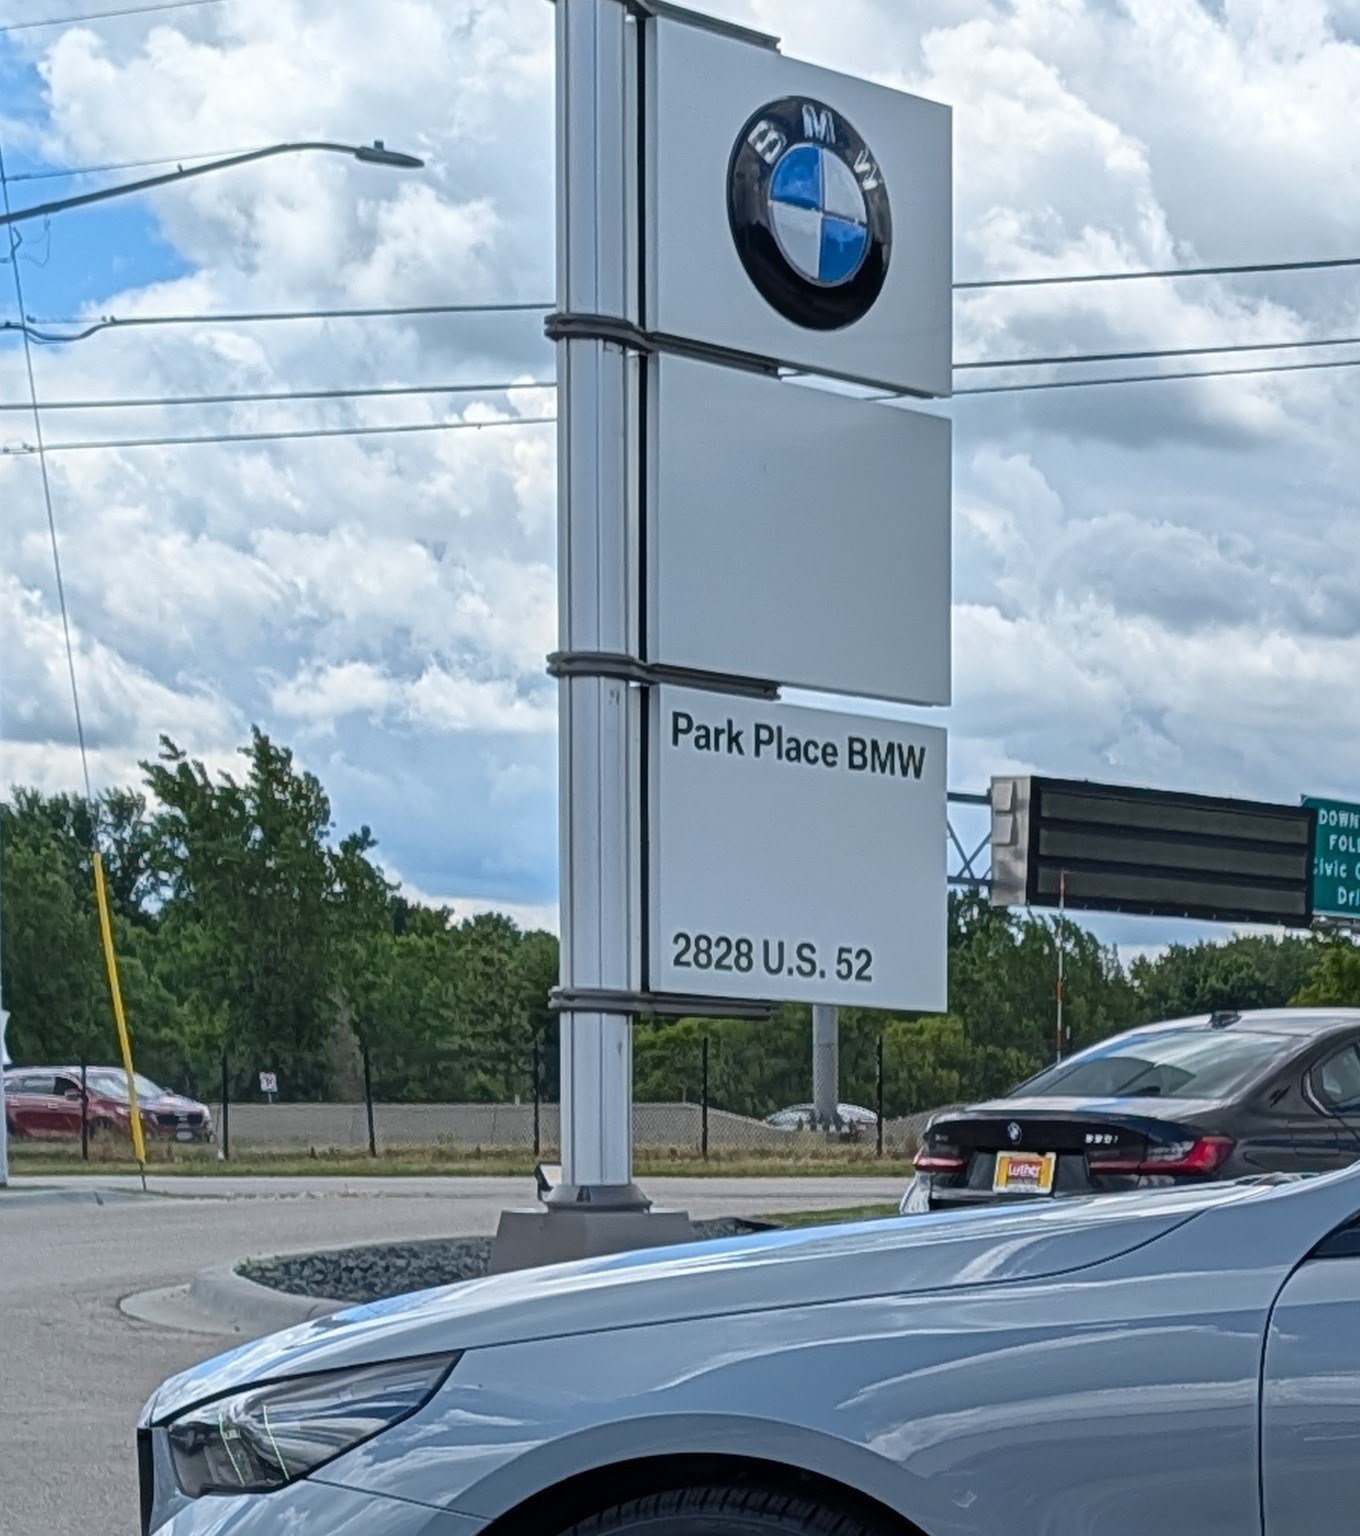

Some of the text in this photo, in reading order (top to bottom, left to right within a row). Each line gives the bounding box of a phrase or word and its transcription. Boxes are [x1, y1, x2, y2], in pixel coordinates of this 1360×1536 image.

[748, 104, 880, 191] BMW
[671, 711, 926, 780] Park Place BMW
[672, 932, 873, 982] 2828 U.S. 52
